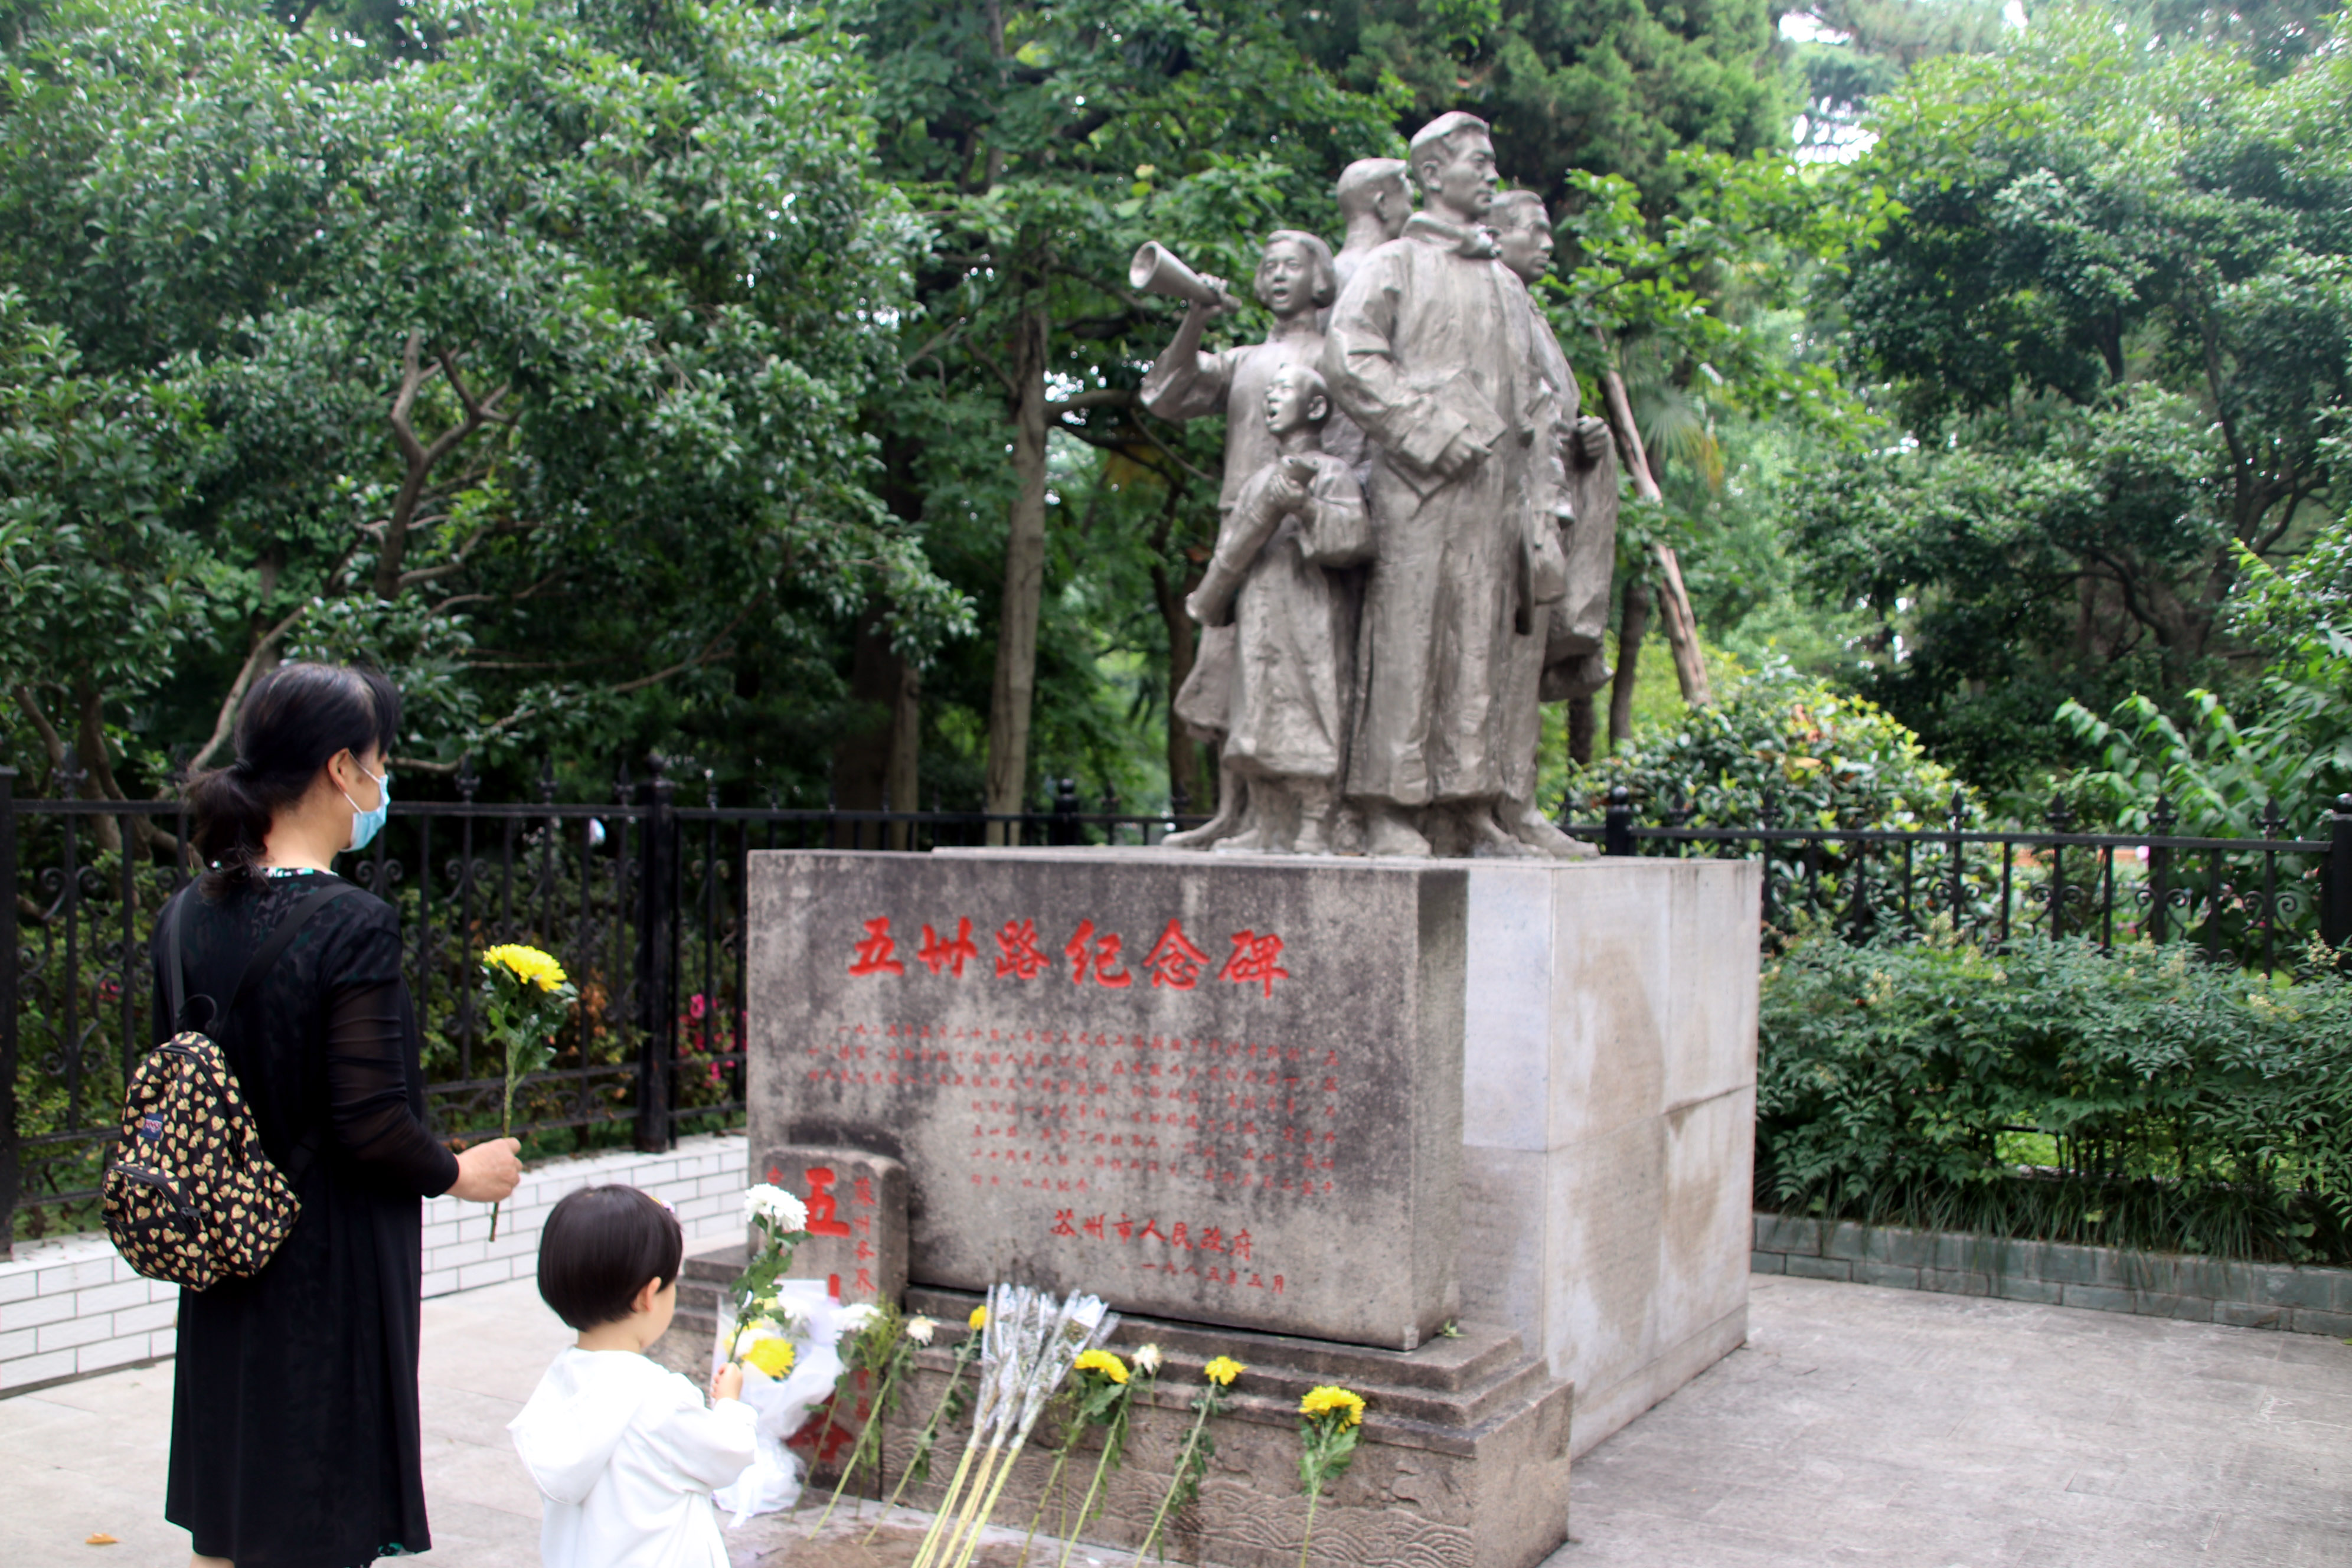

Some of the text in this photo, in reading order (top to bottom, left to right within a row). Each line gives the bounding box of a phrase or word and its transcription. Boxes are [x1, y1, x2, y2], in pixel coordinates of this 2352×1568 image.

[848, 916, 1288, 998] 五卅路纪念碑
[1050, 1208, 1252, 1260] 苏州市人民政府
[1141, 1262, 1285, 1295] 一九八五年五月
